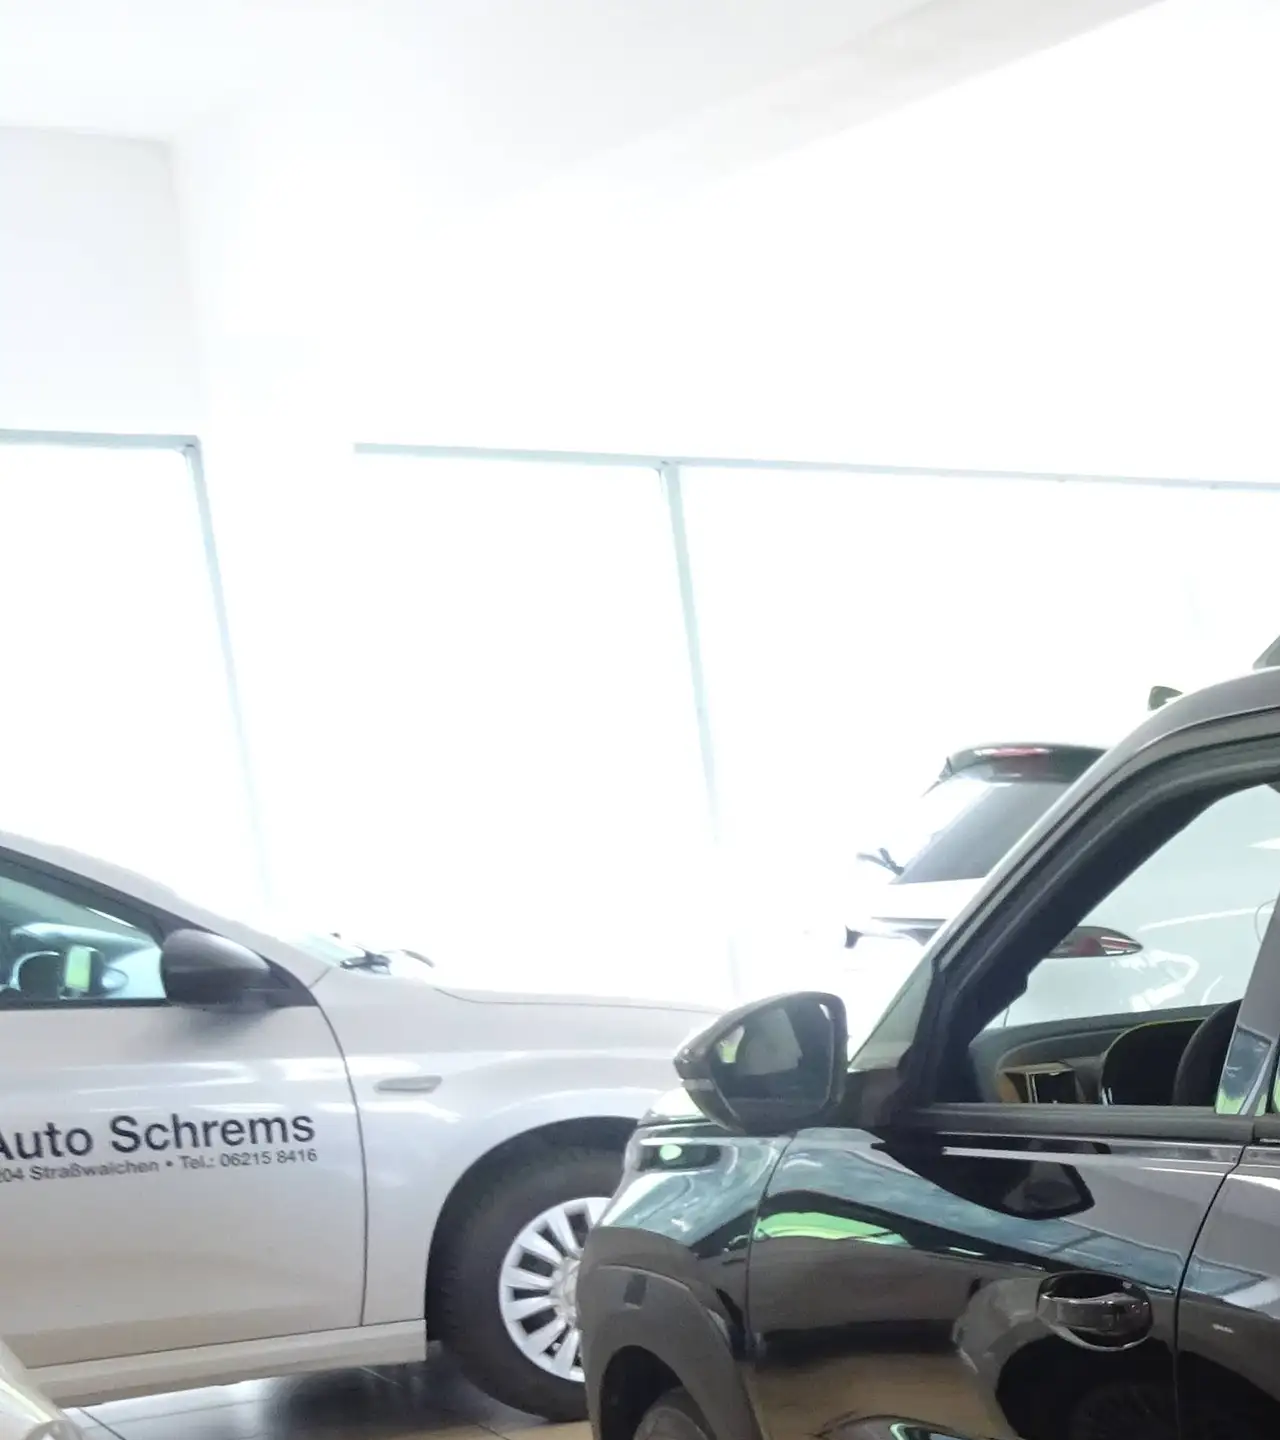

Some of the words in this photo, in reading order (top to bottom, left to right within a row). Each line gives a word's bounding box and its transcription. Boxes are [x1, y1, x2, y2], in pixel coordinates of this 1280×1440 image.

[109, 1112, 316, 1153] Schrems
[219, 1150, 272, 1168] 06215
[276, 1147, 318, 1164] 8416
